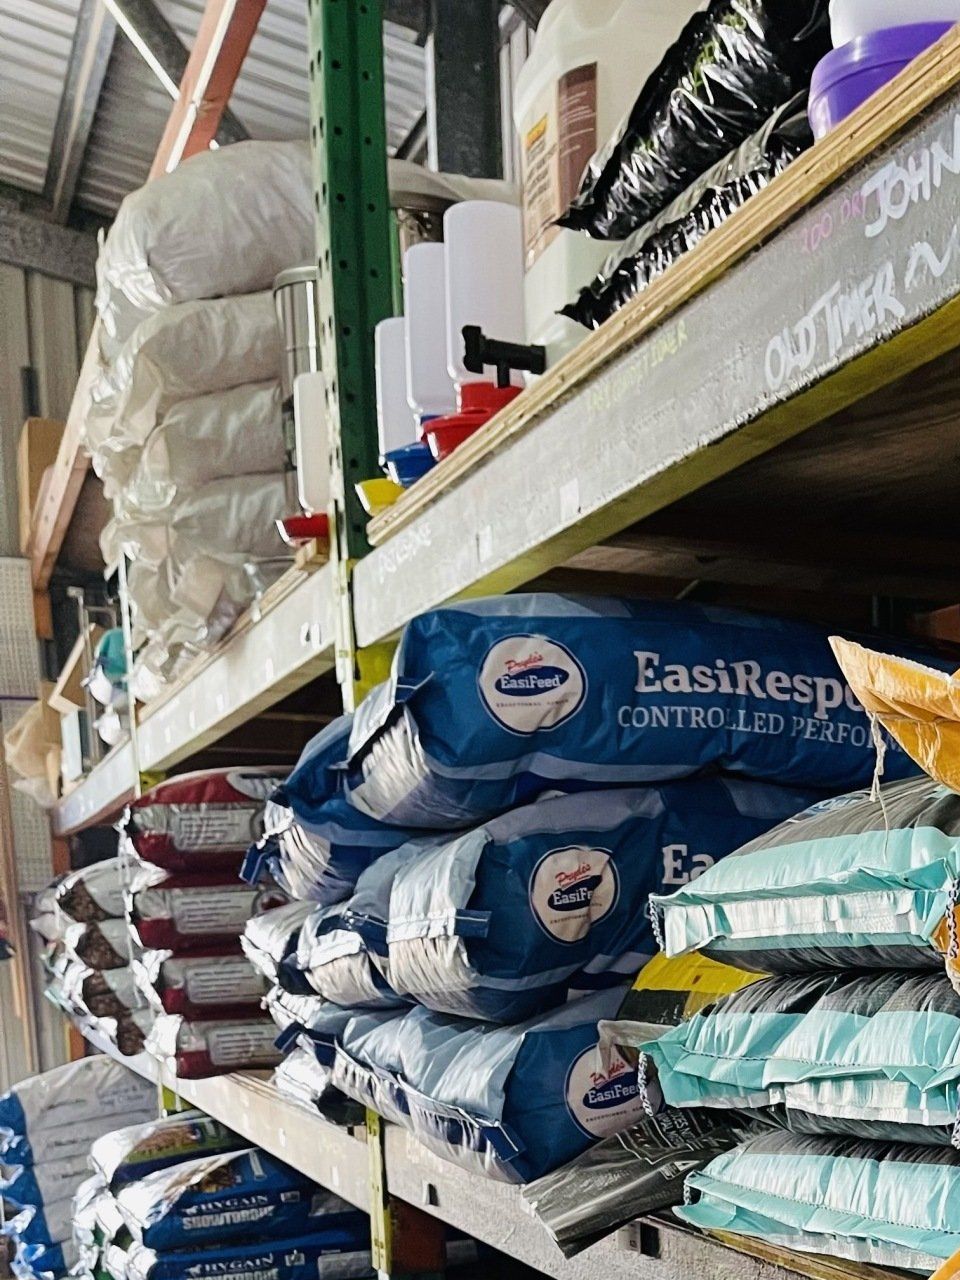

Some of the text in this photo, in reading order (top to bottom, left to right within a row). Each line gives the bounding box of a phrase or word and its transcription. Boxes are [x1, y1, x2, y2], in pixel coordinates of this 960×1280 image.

[500, 674, 561, 689] EasiFeed
[618, 705, 785, 736] CONTROLLED
[204, 1252, 275, 1273] HYGAIN
